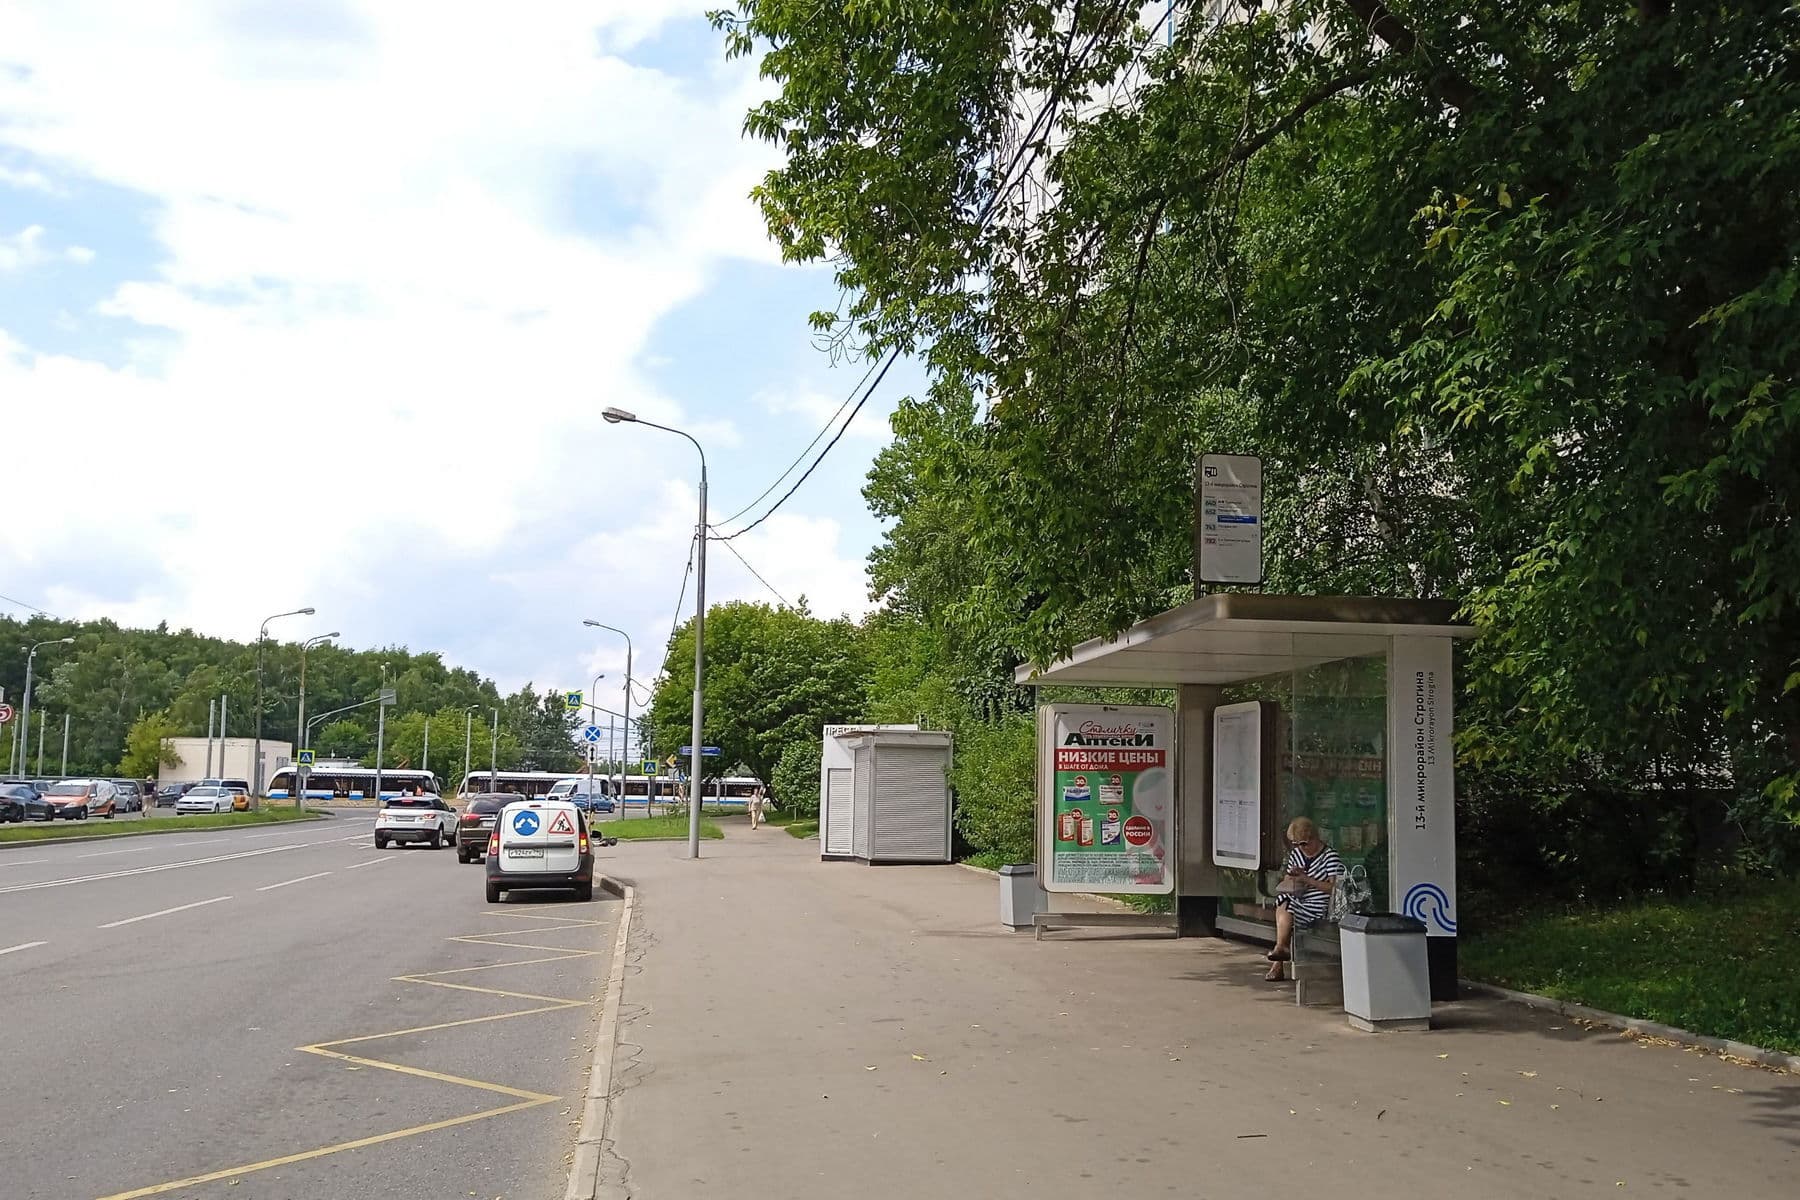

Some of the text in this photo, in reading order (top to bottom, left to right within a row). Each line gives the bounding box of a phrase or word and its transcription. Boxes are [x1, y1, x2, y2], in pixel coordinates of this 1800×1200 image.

[1428, 671, 1436, 765] 13 Mikrorayon Strogina
[1058, 751, 1159, 765] НИЗКИЕ ЦЕНЫ
[1089, 763, 1109, 771] ДОМА
[1414, 671, 1427, 830] 13-й микрорайон Строгина
